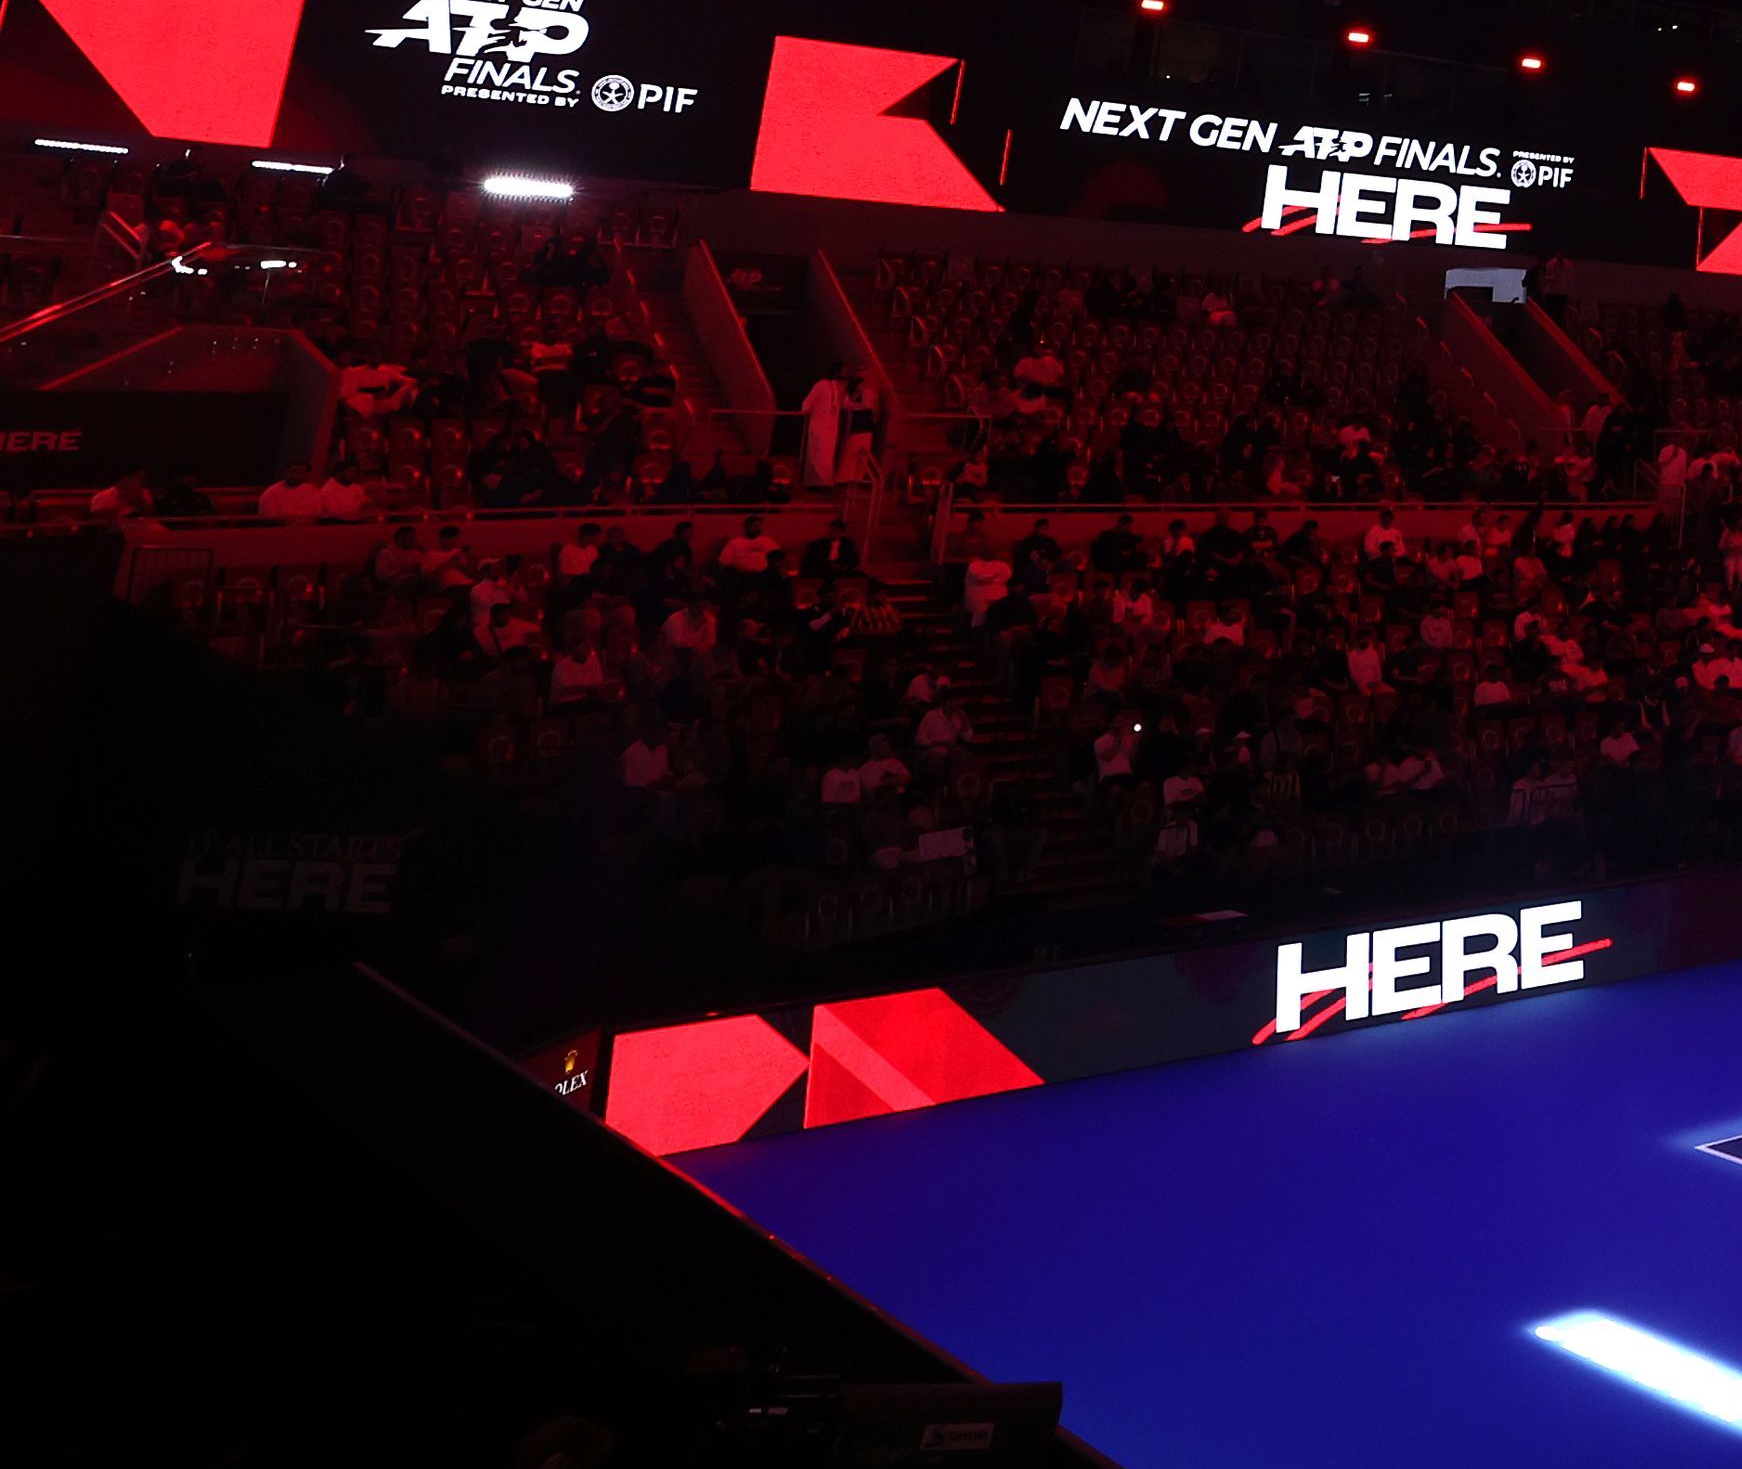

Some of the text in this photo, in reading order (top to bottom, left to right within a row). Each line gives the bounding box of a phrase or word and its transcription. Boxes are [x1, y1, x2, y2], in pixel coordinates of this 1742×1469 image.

[440, 84, 580, 109] PRESENTED BY
[637, 83, 698, 114] PIF
[1060, 97, 1186, 142] NEXT
[1189, 113, 1278, 153] GEN
[1278, 125, 1373, 163] ATP
[1538, 165, 1574, 189] PIF
[1261, 164, 1511, 249] HERE
[175, 856, 398, 915] HERE
[1275, 900, 1585, 1033] HERE
[554, 1070, 589, 1096] OLEX
